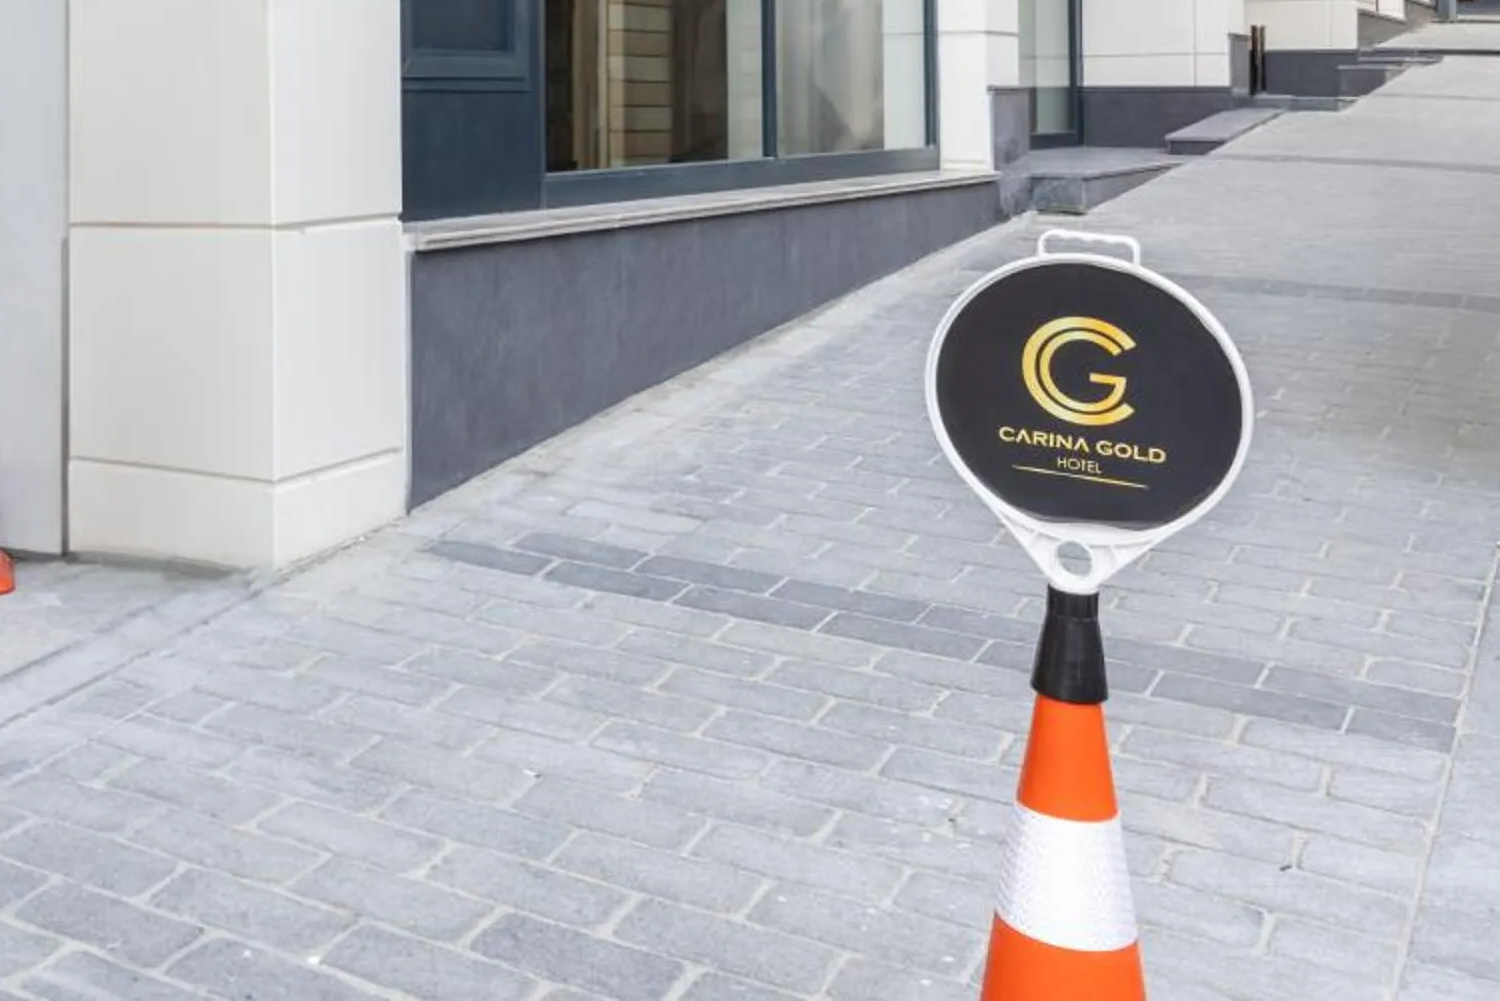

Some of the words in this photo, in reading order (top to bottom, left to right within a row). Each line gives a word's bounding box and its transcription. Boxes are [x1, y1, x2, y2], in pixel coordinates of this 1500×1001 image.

[998, 425, 1090, 453] CARINA
[1095, 440, 1167, 464] GOLD
[1056, 456, 1104, 475] HOTEL
